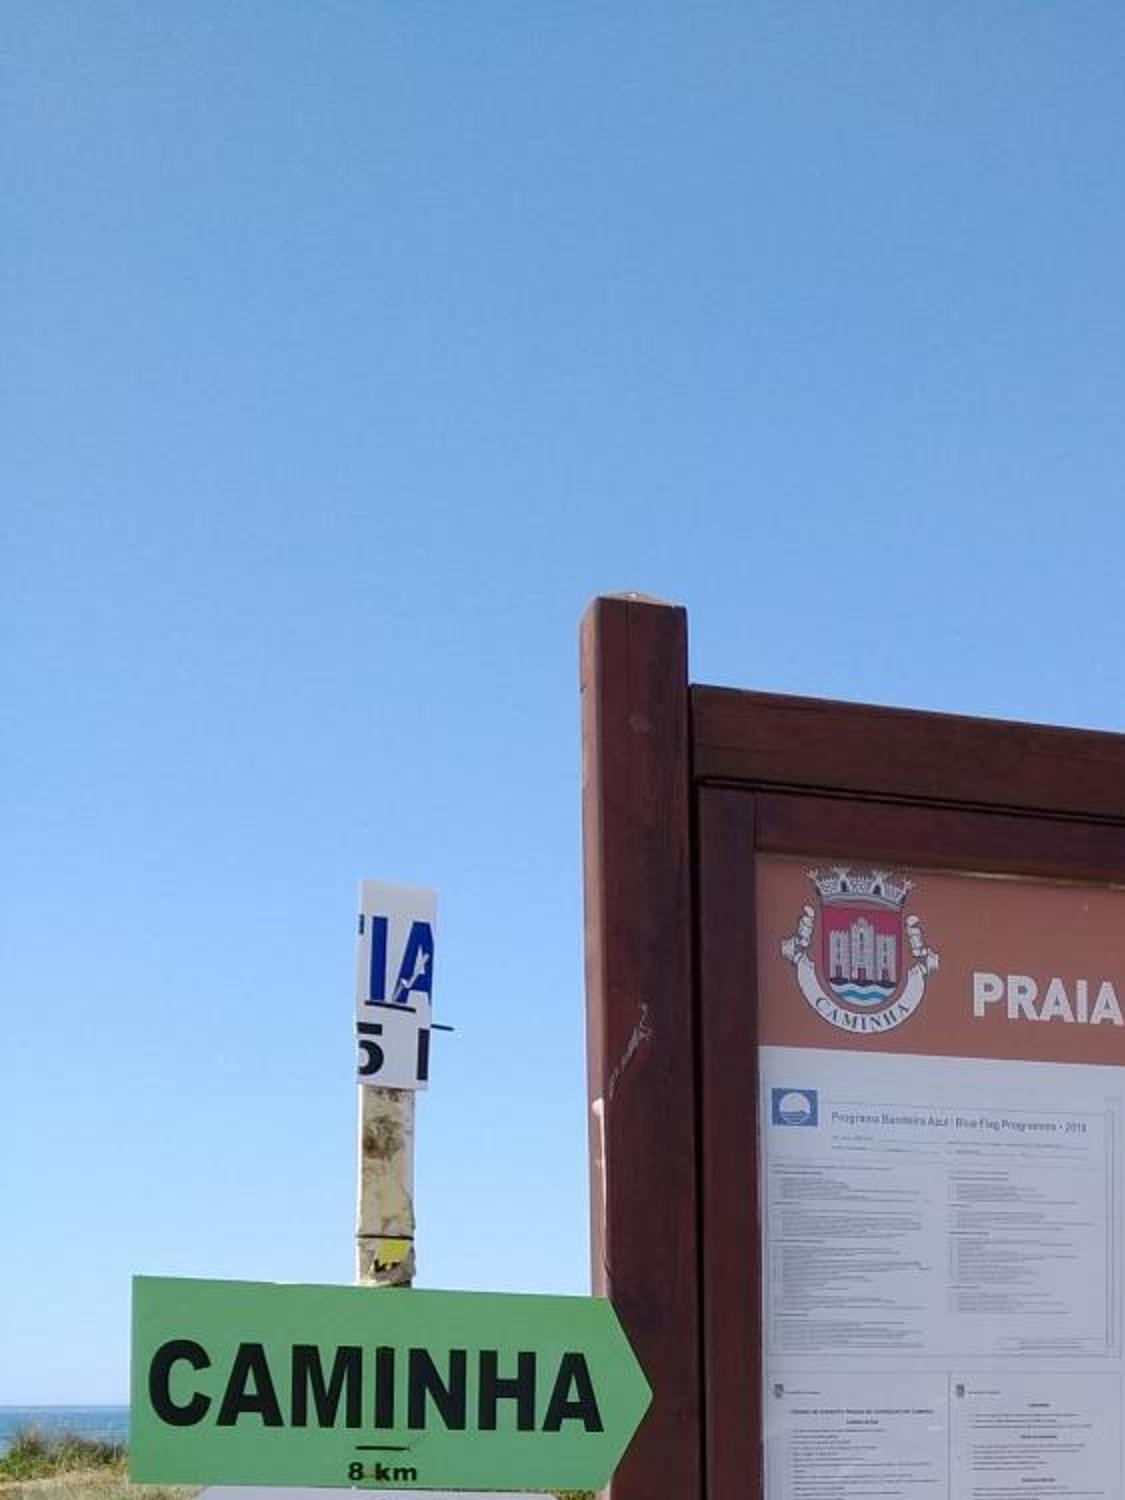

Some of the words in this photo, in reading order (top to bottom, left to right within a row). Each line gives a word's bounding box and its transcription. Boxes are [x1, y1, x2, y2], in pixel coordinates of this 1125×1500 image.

[815, 996, 910, 1031] CAMINHA
[972, 971, 1125, 1027] PRAIA
[147, 1338, 605, 1433] CAMINHA
[347, 1461, 365, 1482] 8
[374, 1461, 418, 1482] km
